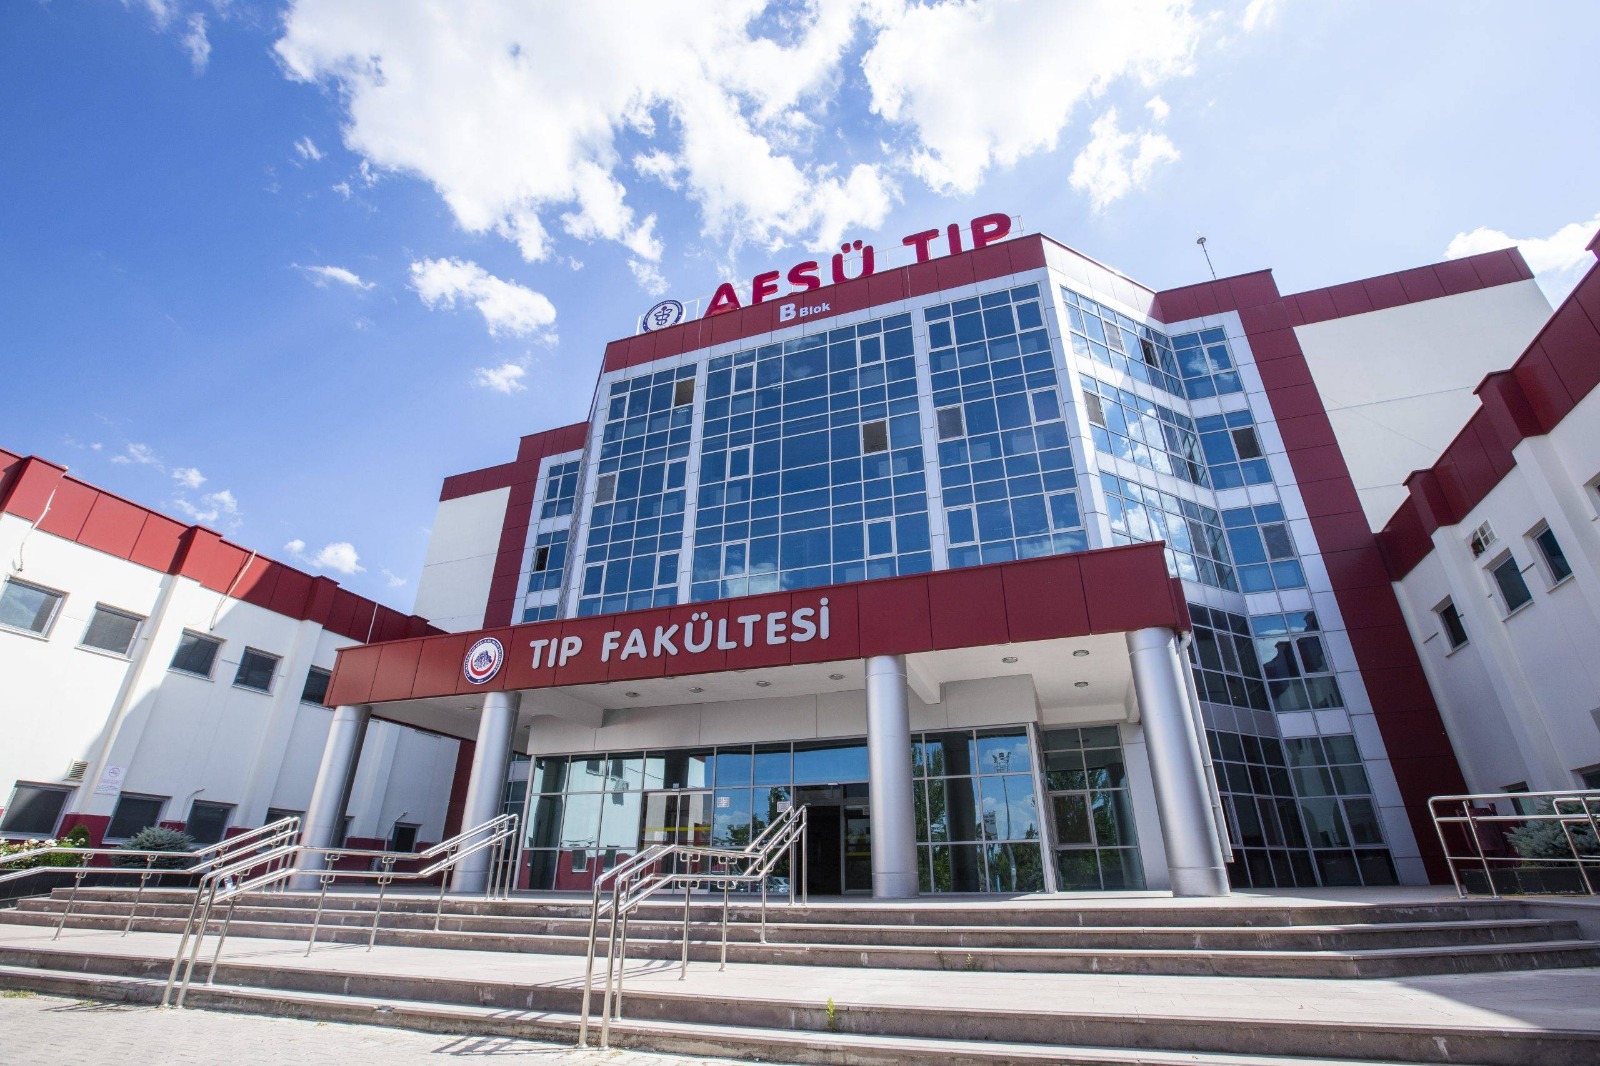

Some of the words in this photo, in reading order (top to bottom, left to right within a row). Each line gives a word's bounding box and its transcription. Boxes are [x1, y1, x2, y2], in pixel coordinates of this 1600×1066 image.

[702, 240, 874, 318] AFSÜ
[902, 213, 1012, 263] TIP
[779, 303, 796, 322] B
[799, 302, 831, 318] Blok
[529, 636, 583, 669] TIP
[600, 597, 830, 663] FAKÜLTESİ
